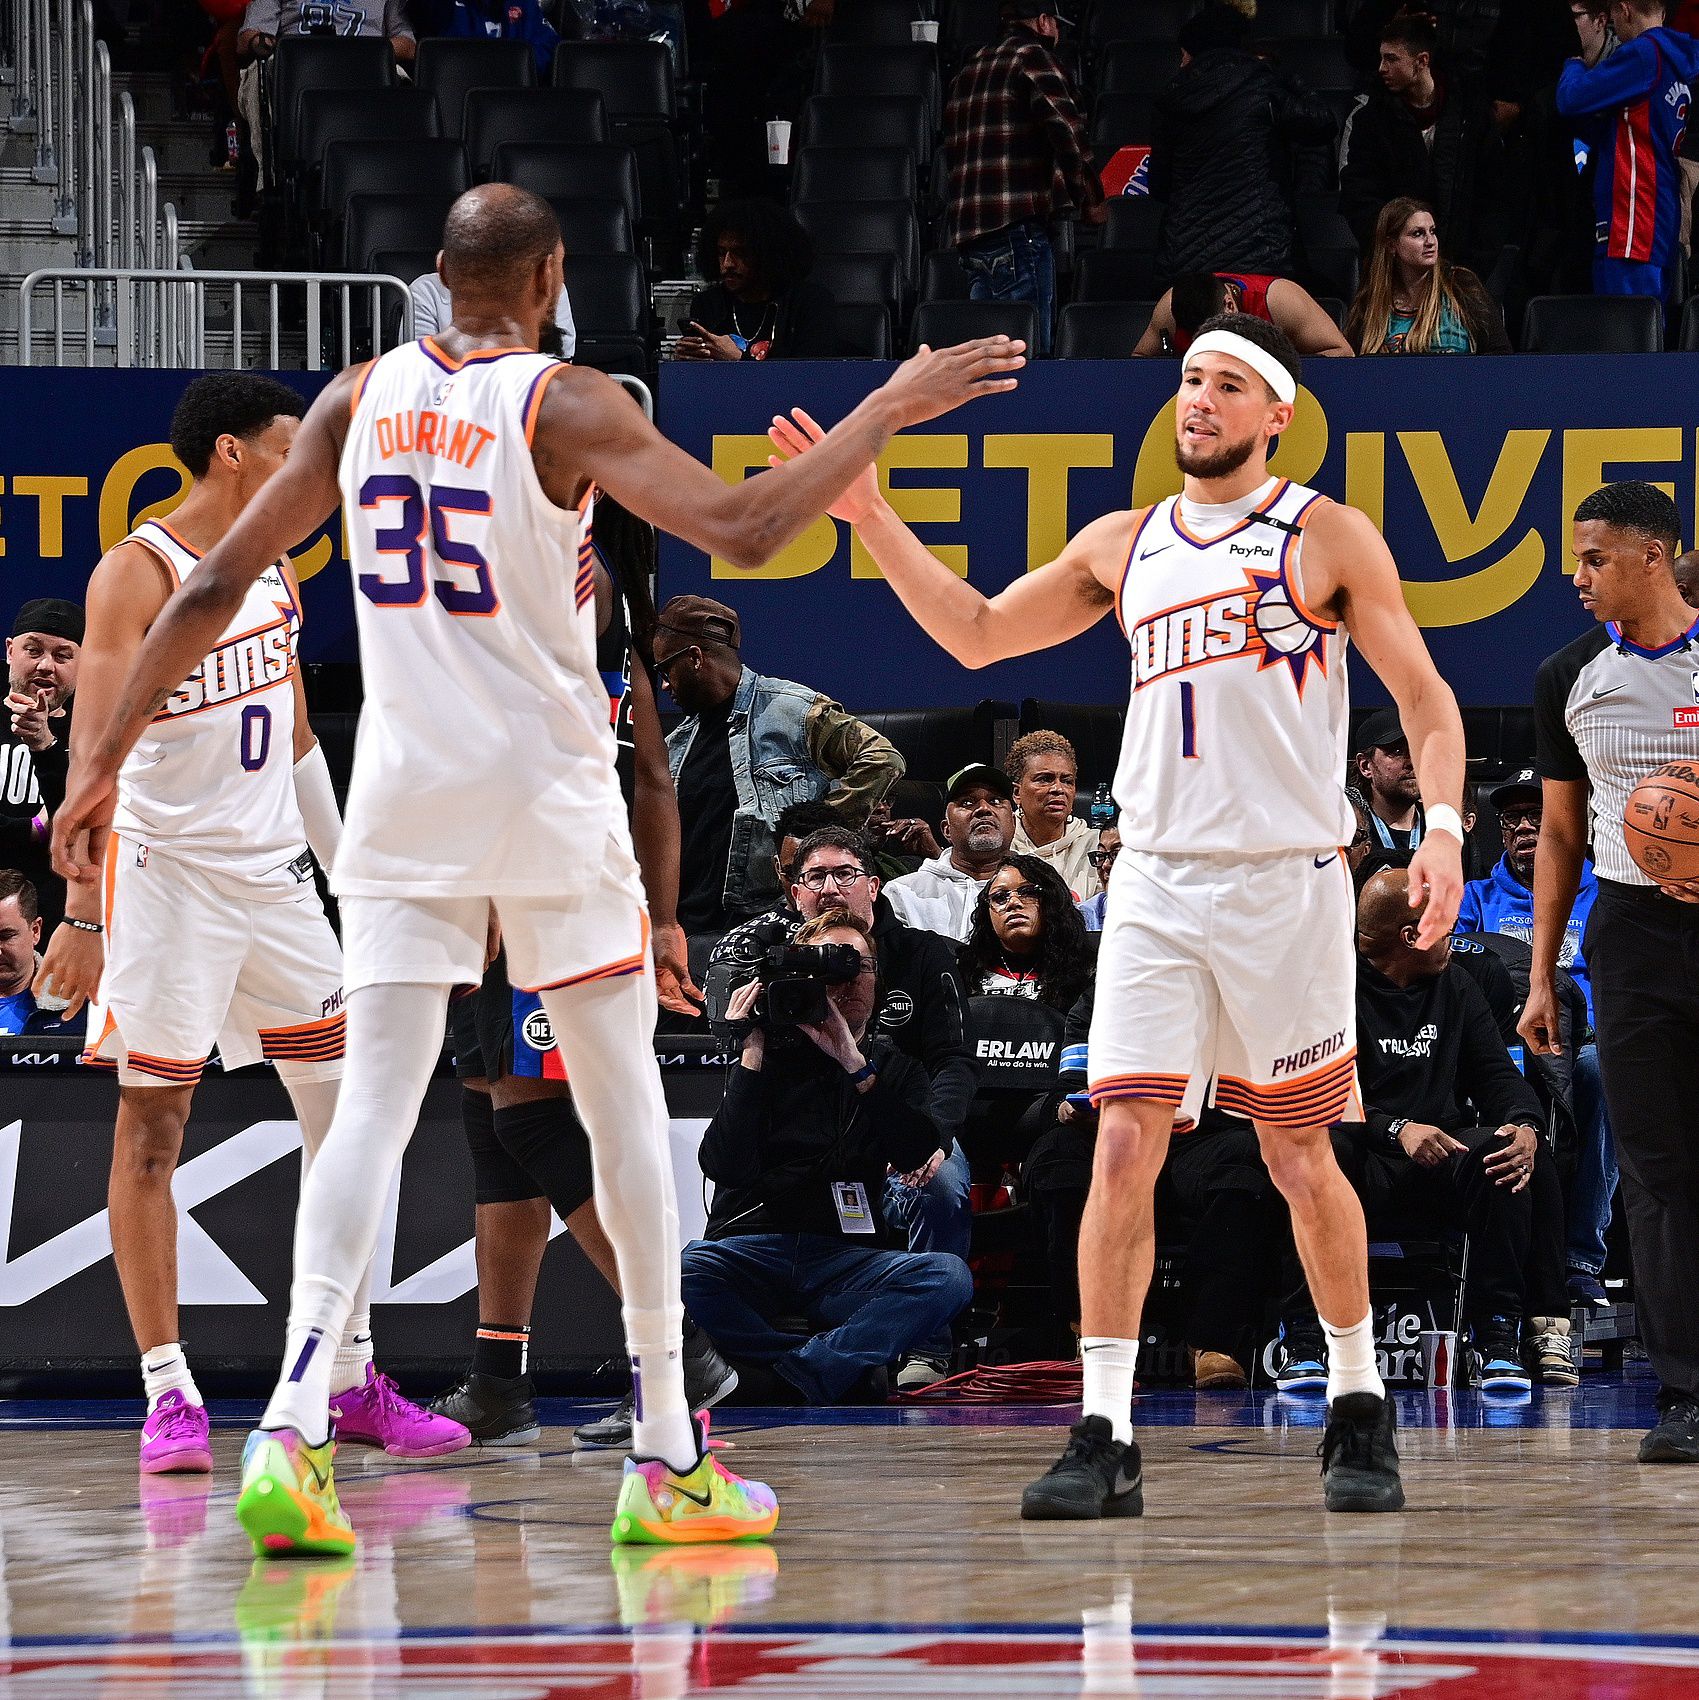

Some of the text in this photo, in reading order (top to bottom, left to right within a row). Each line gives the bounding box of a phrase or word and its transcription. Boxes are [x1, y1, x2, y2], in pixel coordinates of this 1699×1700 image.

[376, 409, 497, 470] DURANT
[359, 474, 502, 618] 35
[1229, 544, 1274, 558] PayPal
[1132, 595, 1248, 683] UNS
[241, 705, 272, 773] 0
[1180, 681, 1200, 759] 1
[1271, 1027, 1346, 1077] PHOENIX
